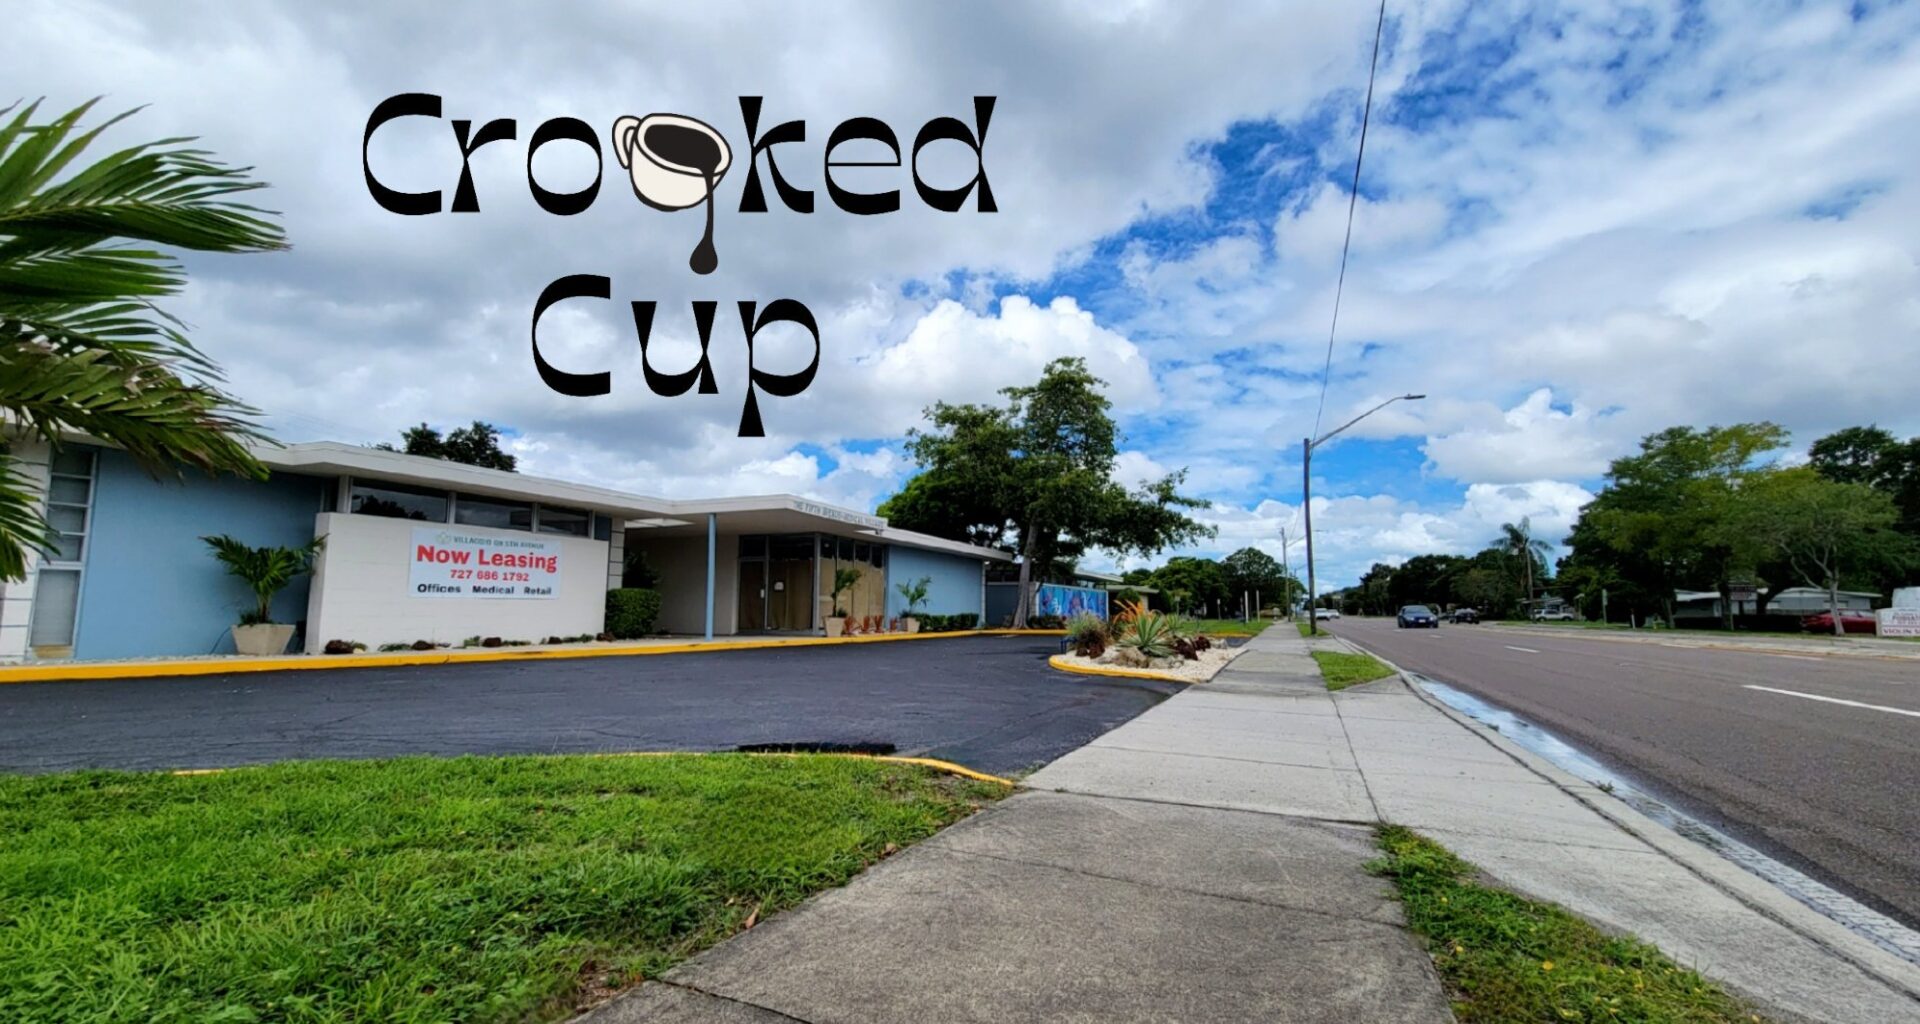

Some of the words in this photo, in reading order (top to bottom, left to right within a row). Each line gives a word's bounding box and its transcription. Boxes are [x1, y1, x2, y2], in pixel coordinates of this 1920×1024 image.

[417, 545, 470, 564] Now
[478, 550, 557, 573] Leasing
[450, 569, 473, 580] 727
[477, 571, 498, 581] 686
[502, 572, 529, 582] 1792
[417, 583, 461, 594] Offices
[472, 585, 514, 595] Medical
[524, 586, 551, 595] Retail
